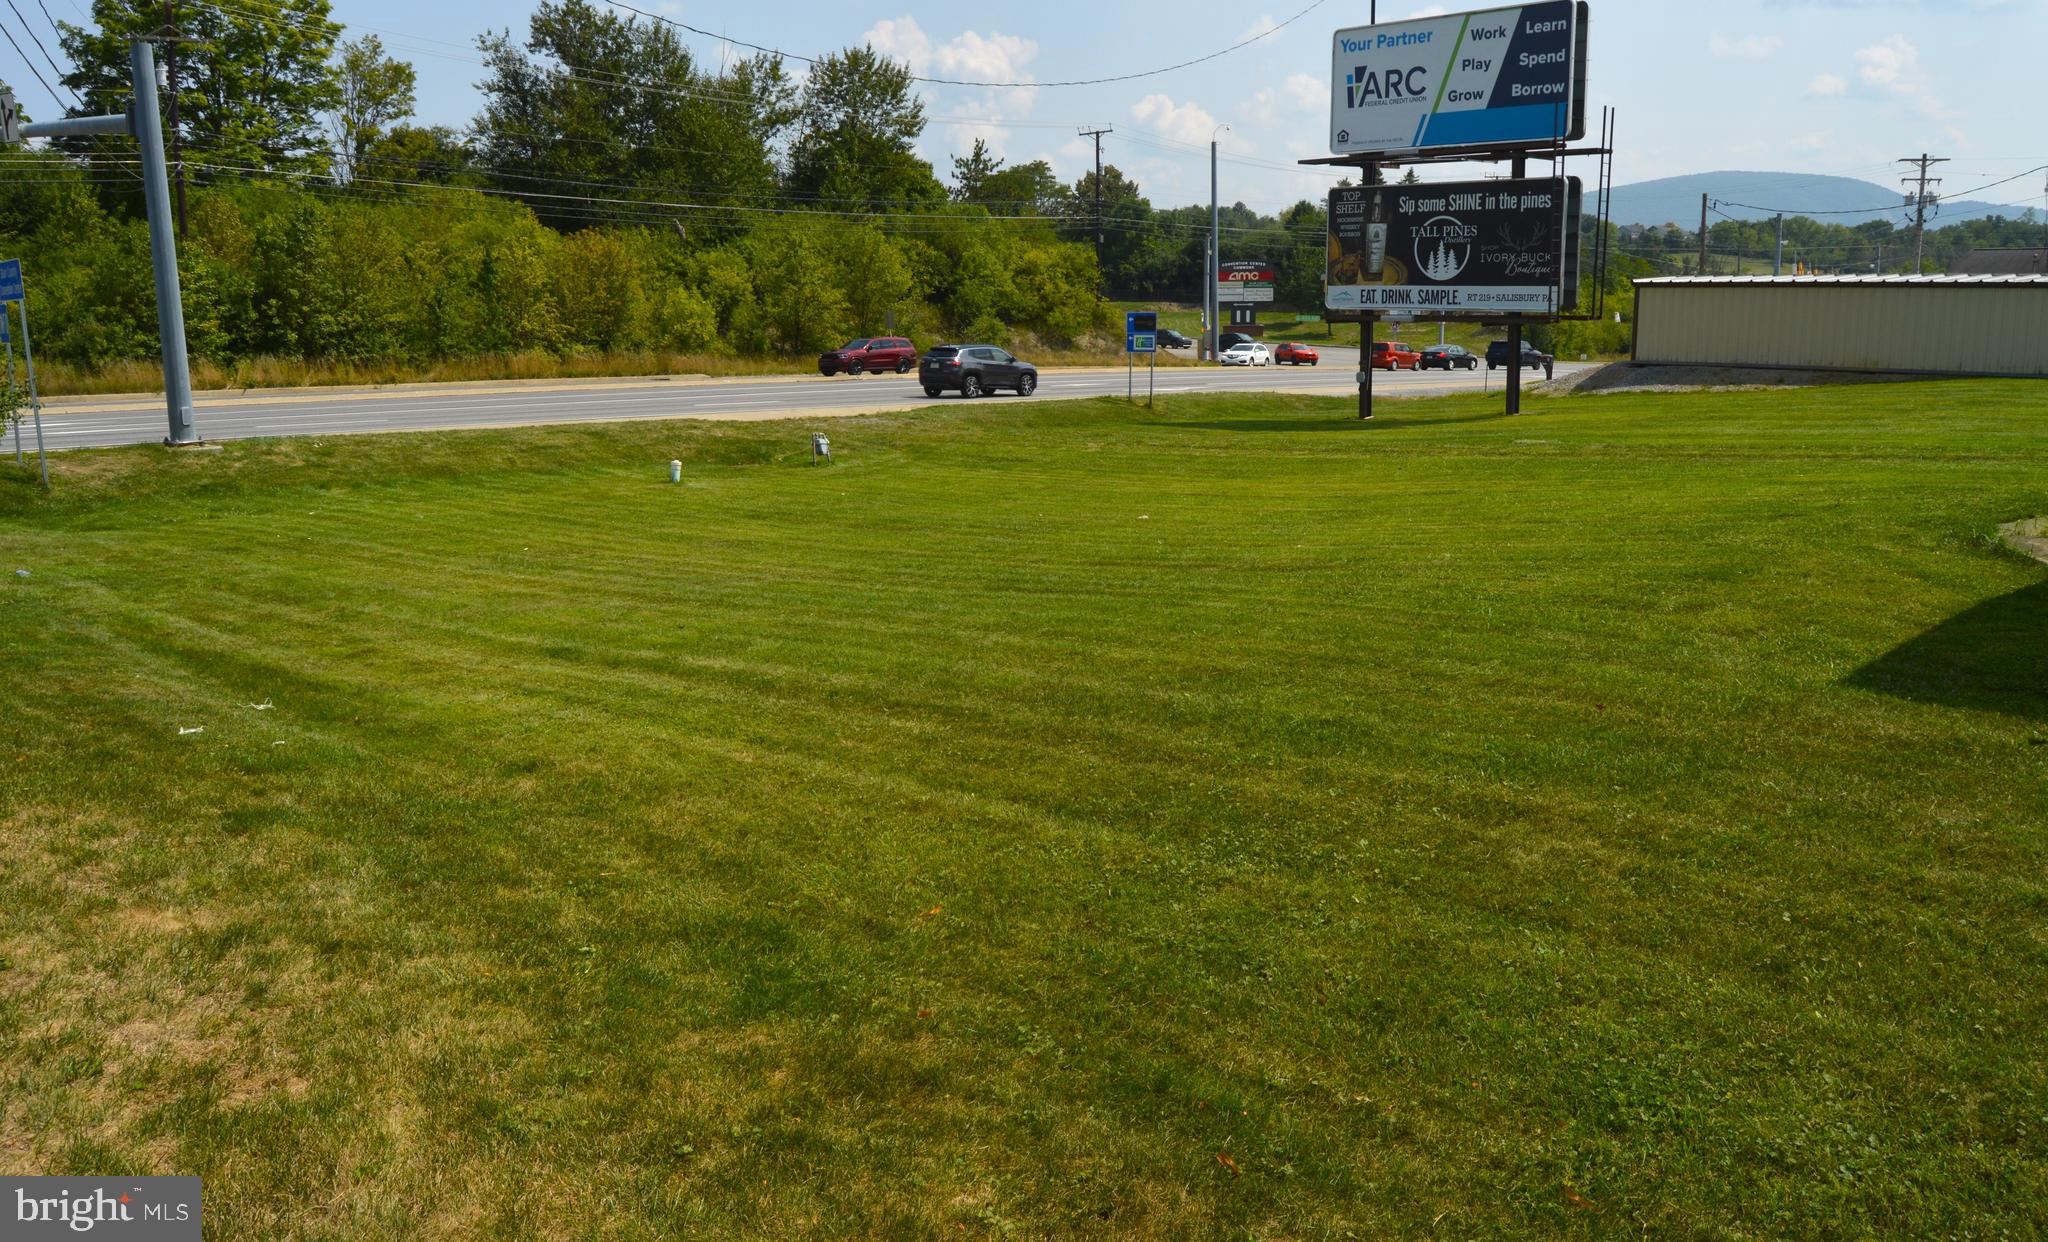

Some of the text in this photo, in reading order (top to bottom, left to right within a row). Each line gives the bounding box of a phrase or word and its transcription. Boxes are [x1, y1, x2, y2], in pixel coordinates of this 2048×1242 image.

[1471, 26, 1507, 41] Work
[1525, 19, 1567, 34] Learn
[1341, 31, 1433, 54] Your Partner
[1519, 49, 1566, 66] Spend
[1462, 58, 1491, 72] Play
[1359, 66, 1427, 107] ARC
[1511, 83, 1565, 97] Borrow
[1364, 96, 1427, 107] FEDERAL CREDIT UNION
[1448, 89, 1484, 102] Grow
[1342, 191, 1361, 201] TOP
[1399, 191, 1552, 215] Sip some SHINE in the pines
[1336, 203, 1366, 214] SHELF
[1410, 225, 1478, 237] TALL PINES
[1480, 252, 1551, 263] IVORY BUCK
[1360, 289, 1461, 305] EAT. DRINK. SAMPLE.
[1467, 293, 1478, 302] RT
[1478, 293, 1492, 302] 219
[1495, 293, 1541, 302] SALISBURY
